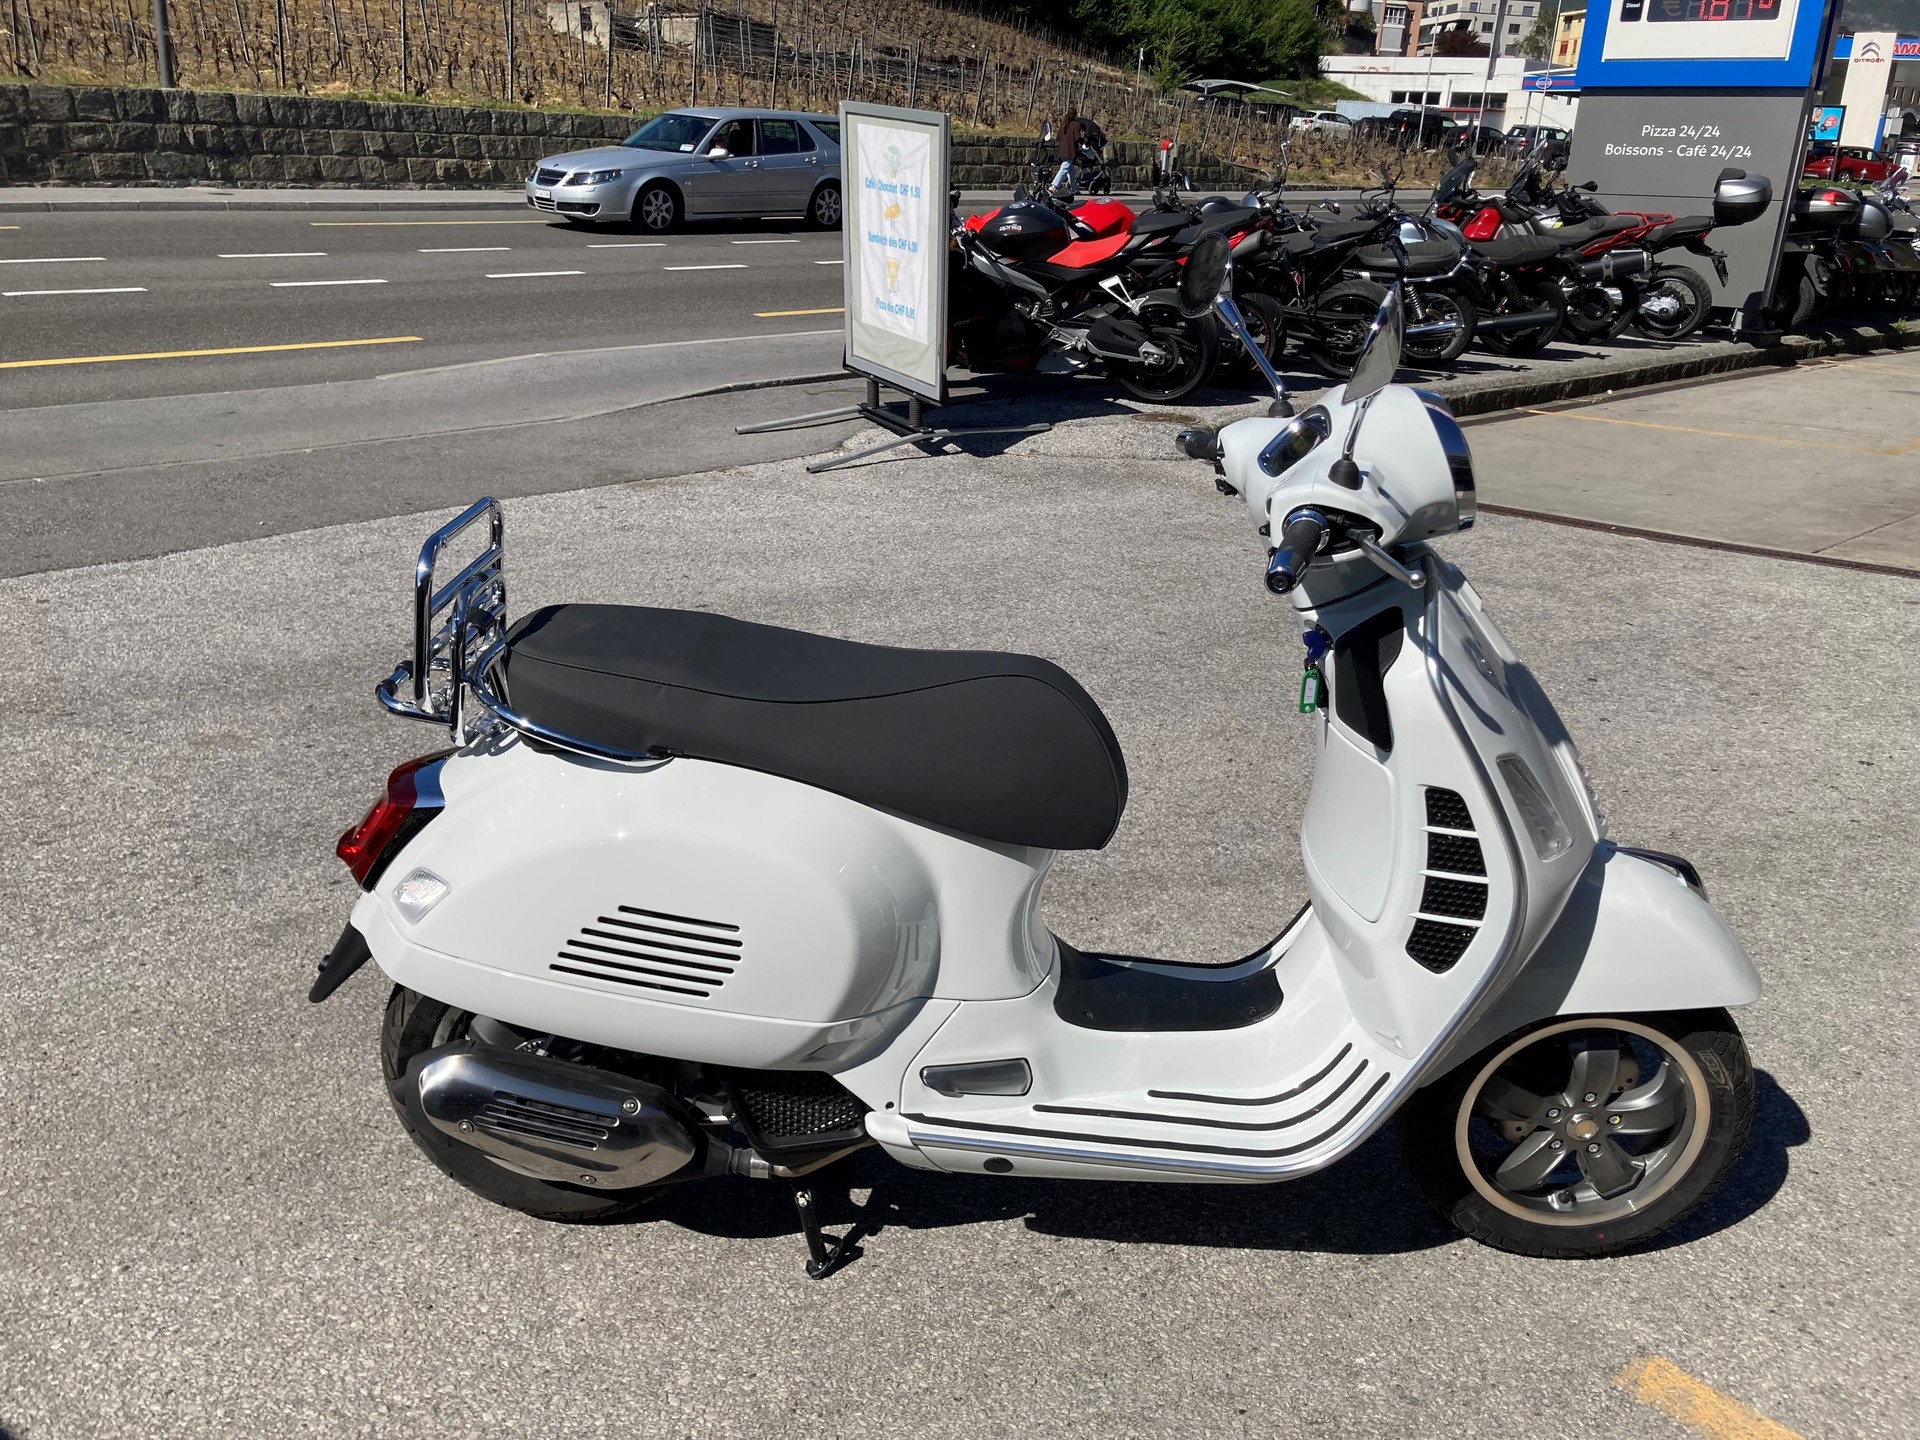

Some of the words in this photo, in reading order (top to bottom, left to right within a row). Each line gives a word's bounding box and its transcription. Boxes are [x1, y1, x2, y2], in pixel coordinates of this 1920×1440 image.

[1641, 124, 1676, 137] Pizza
[1678, 125, 1721, 140] 24/24
[1604, 143, 1664, 156] Boissons
[1676, 144, 1707, 157] Café
[1709, 145, 1752, 160] 24/24
[900, 184, 909, 196] CHF
[999, 223, 1022, 232] aprilia
[898, 238, 907, 251] CHF
[895, 304, 905, 316] CHF
